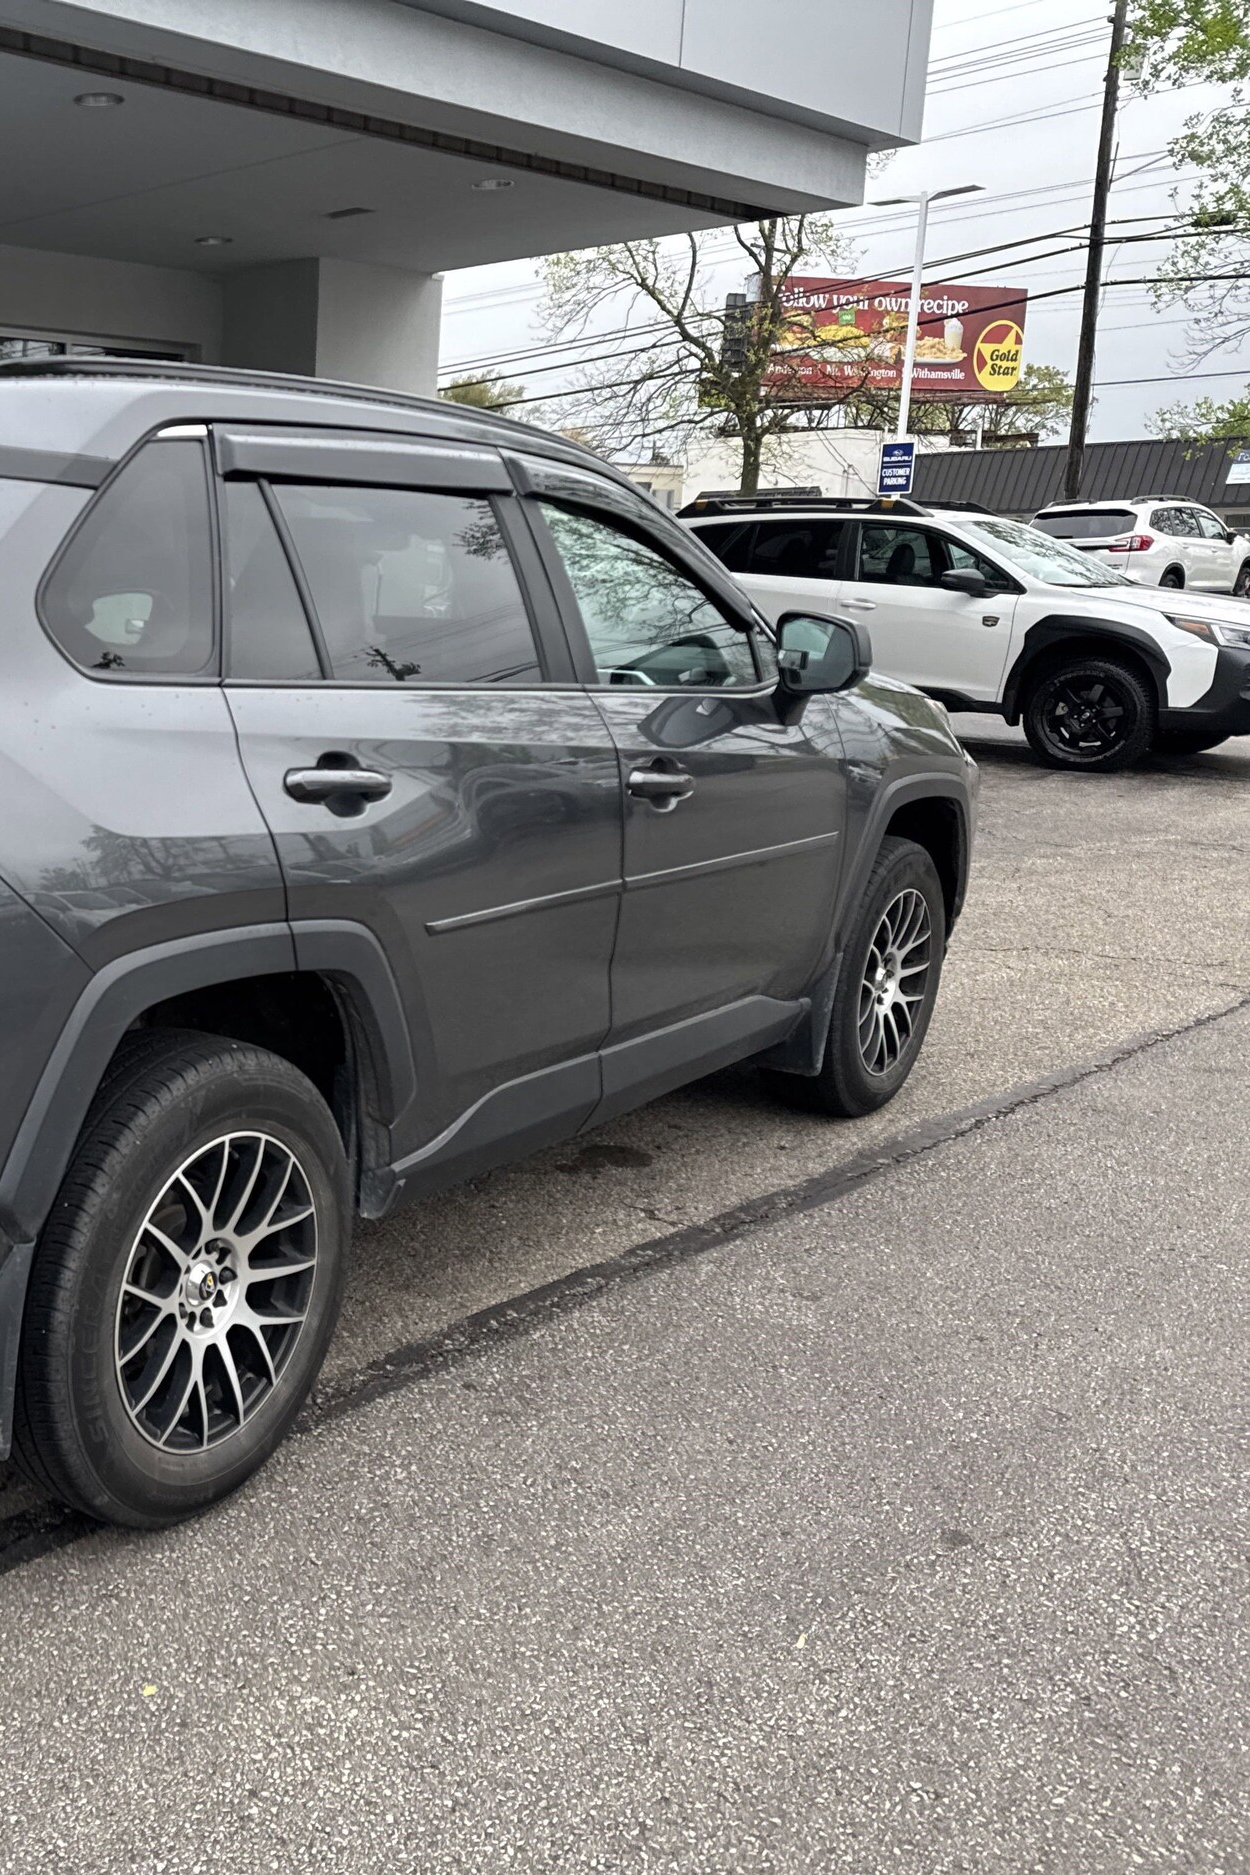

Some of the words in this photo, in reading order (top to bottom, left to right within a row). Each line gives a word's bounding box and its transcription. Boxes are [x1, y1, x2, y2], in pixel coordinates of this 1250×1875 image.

[832, 294, 869, 314] your
[874, 296, 911, 312] own
[917, 295, 969, 316] recipe
[990, 349, 1019, 362] Gold
[767, 363, 813, 375] Andeon
[844, 364, 897, 380] Wington
[911, 367, 965, 380] Withamsville
[989, 363, 1017, 376] Star
[882, 468, 910, 476] CUSTOMER
[883, 477, 907, 486] PARKING
